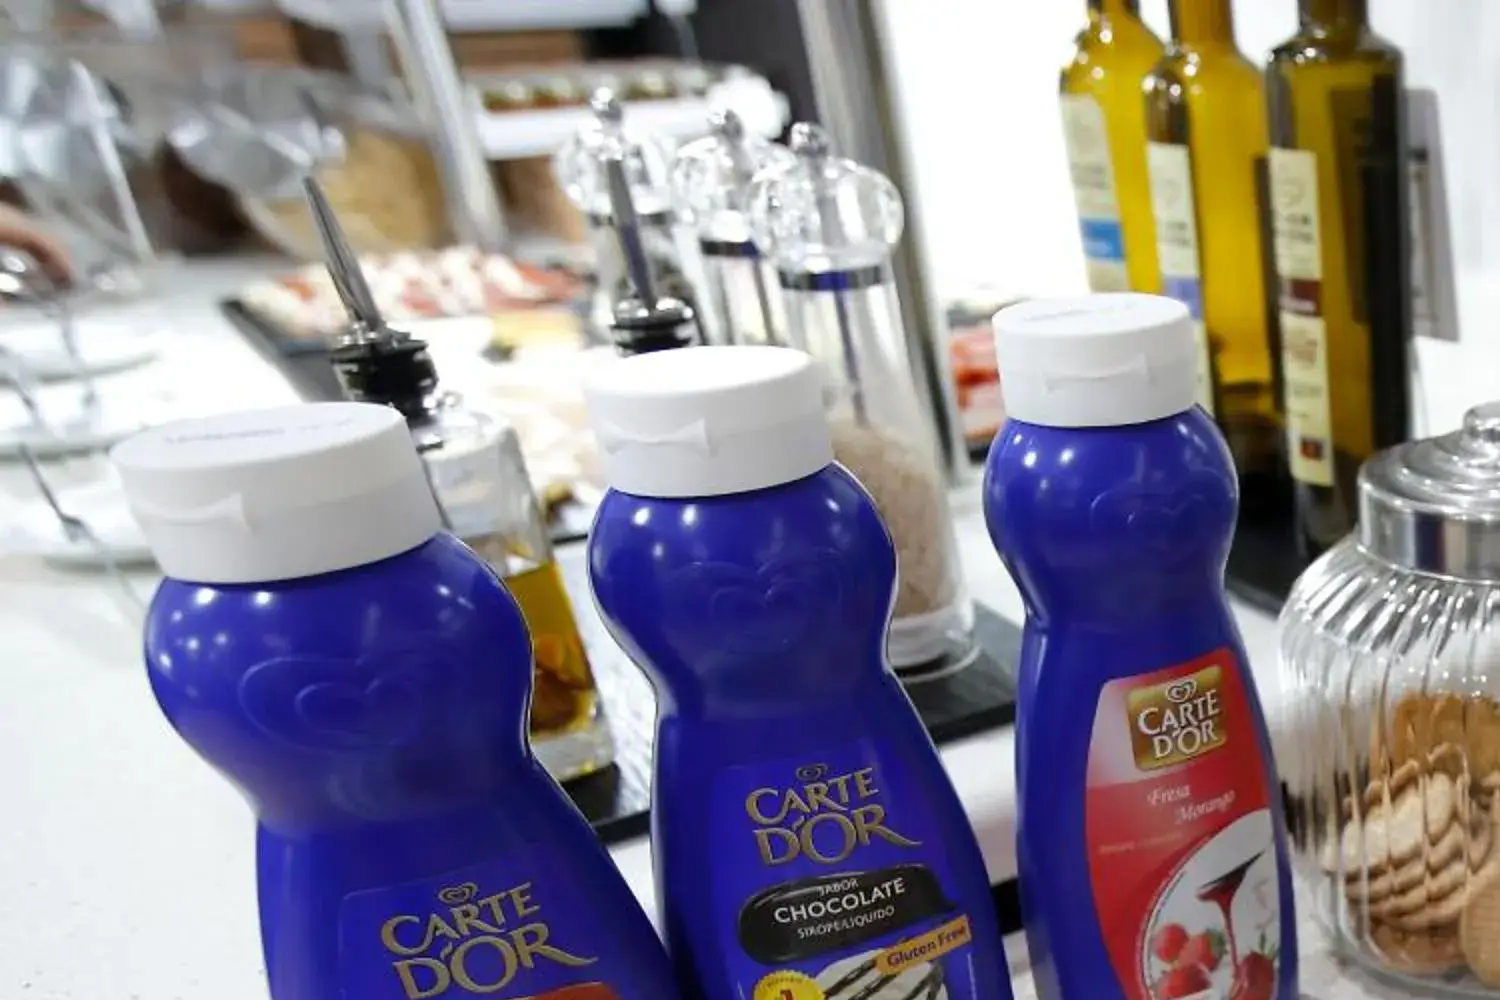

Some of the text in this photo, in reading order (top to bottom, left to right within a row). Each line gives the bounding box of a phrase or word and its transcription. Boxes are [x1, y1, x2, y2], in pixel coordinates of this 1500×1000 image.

[1137, 689, 1220, 736] CARTE
[1152, 719, 1219, 759] D'OR
[745, 767, 880, 825] CARTE
[752, 804, 923, 866] D'OR
[381, 882, 541, 955] CARTE
[773, 876, 907, 925] CHOCOLATE
[392, 922, 599, 1000] D'OR
[886, 923, 967, 967] Gluten Free
